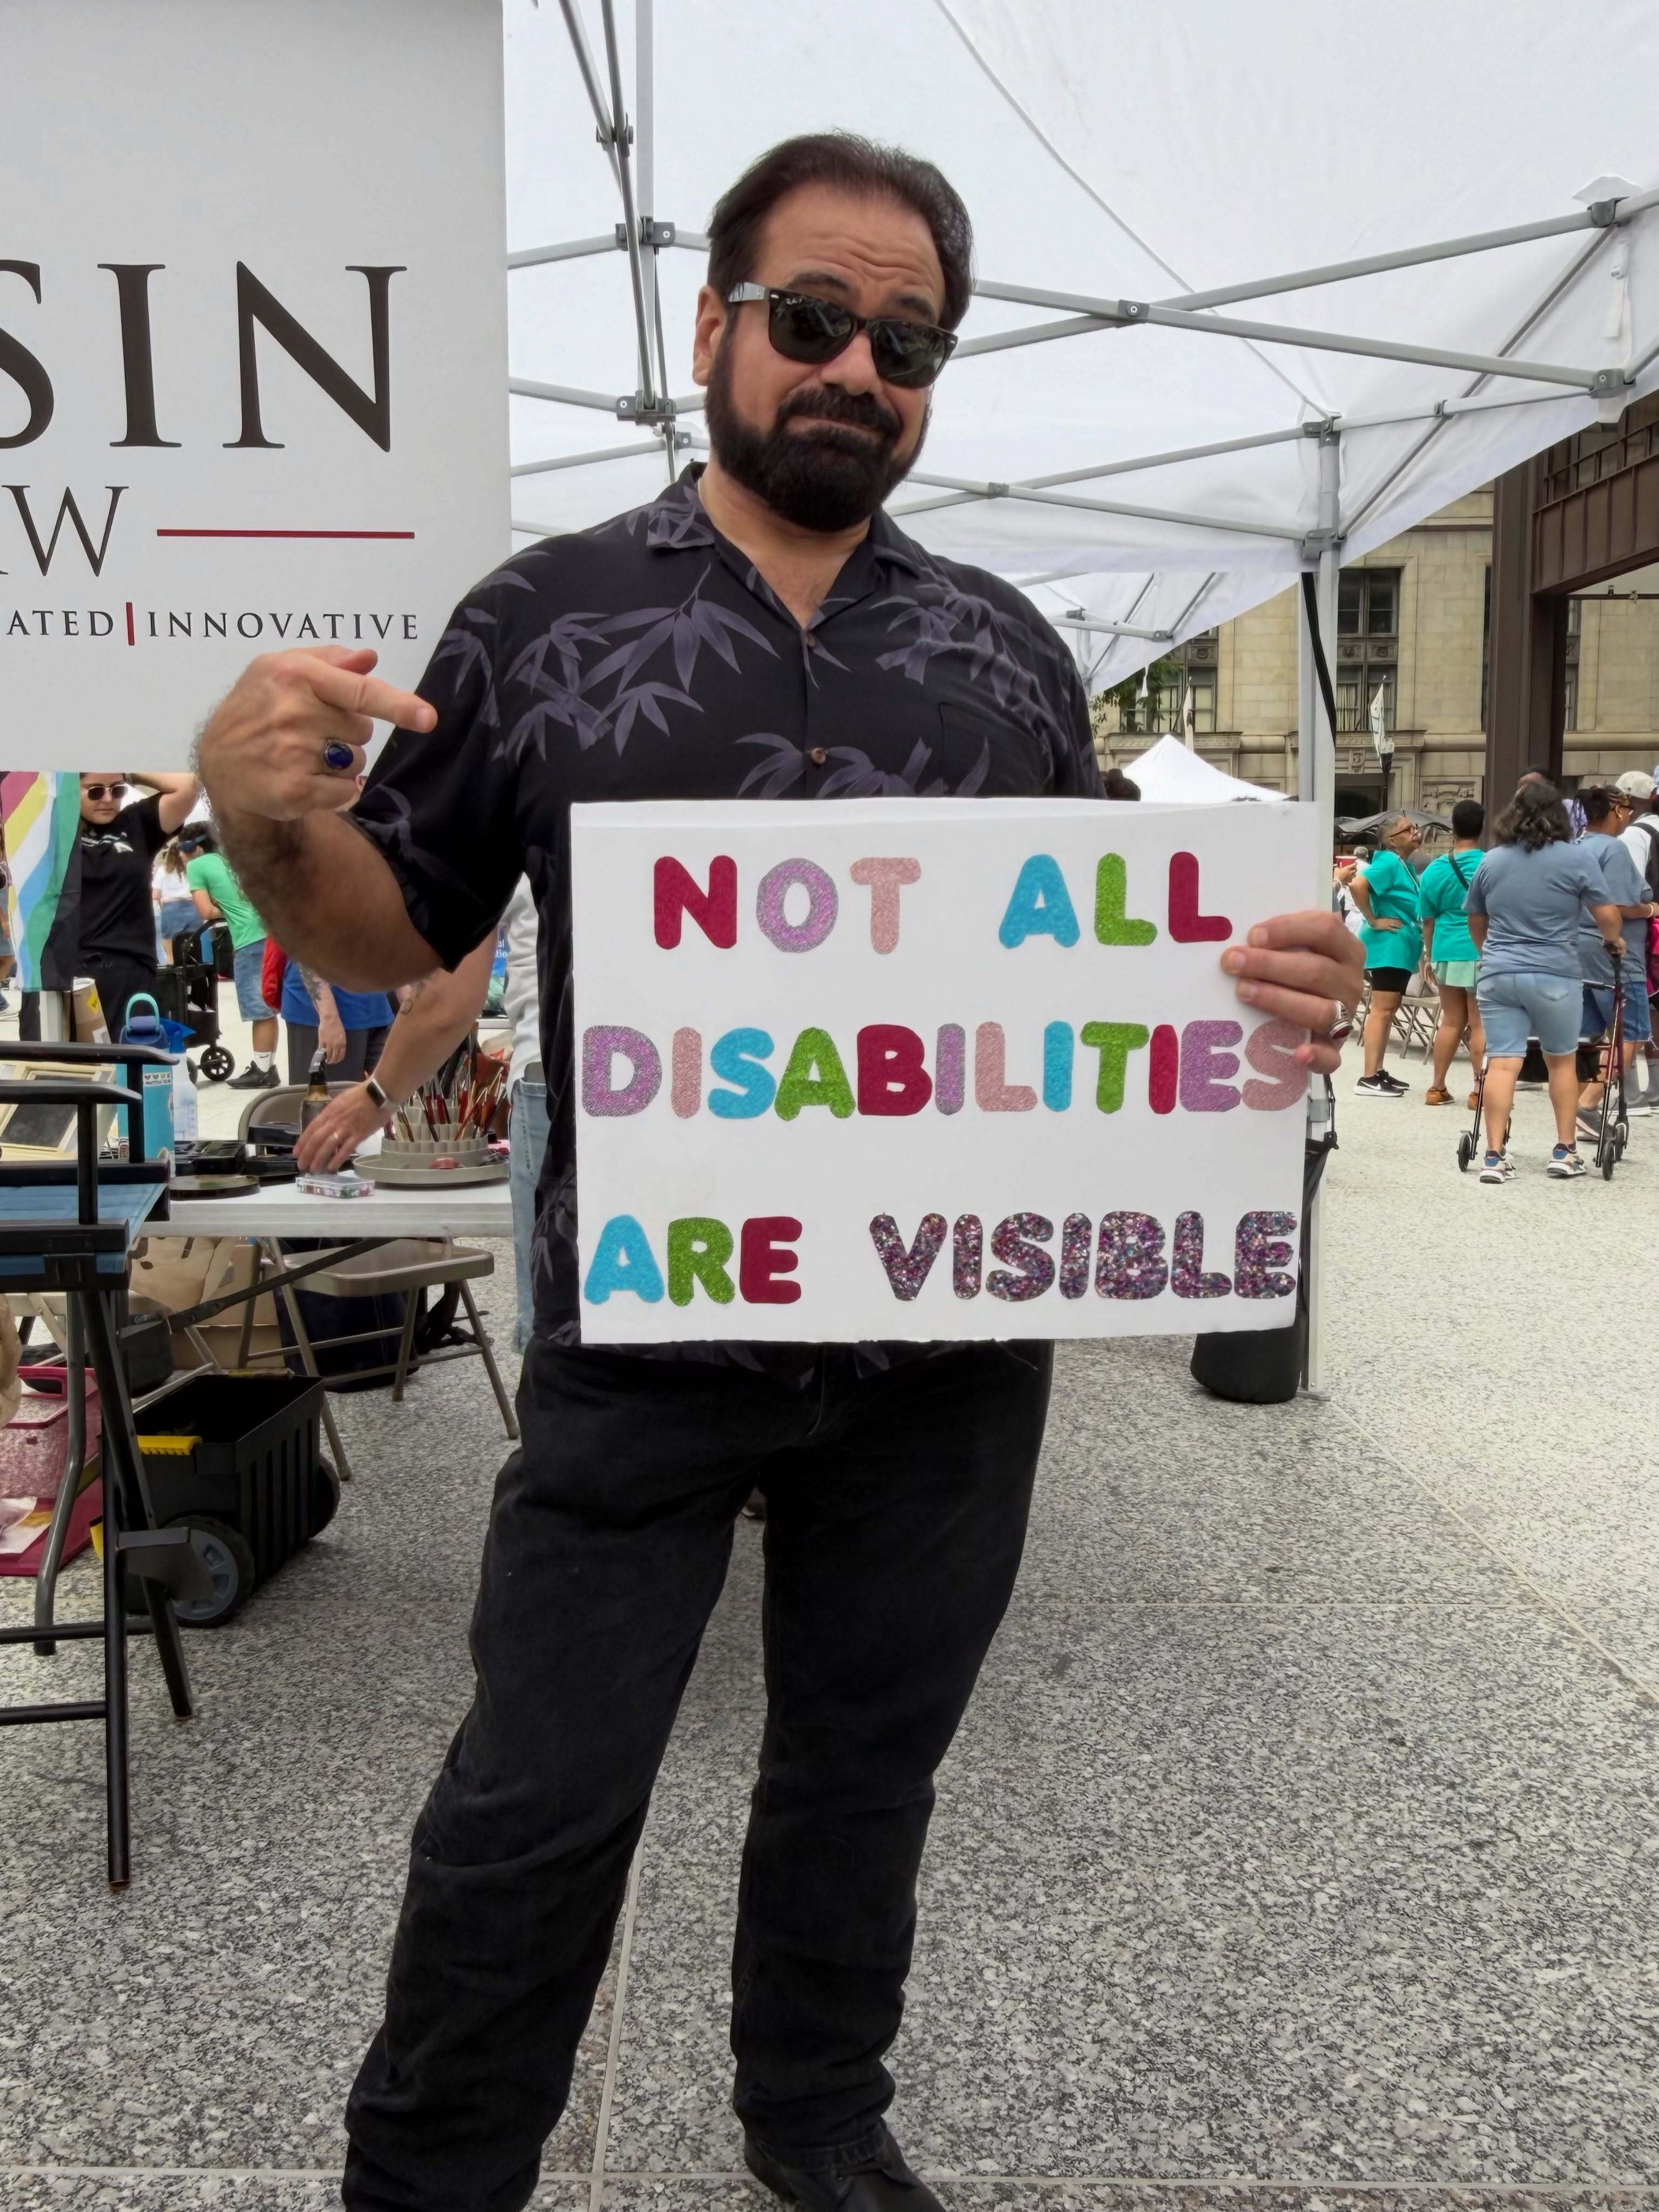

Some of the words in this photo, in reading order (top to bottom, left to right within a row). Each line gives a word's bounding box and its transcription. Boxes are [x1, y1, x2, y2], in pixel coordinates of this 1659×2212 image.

[0, 485, 129, 577] W
[149, 611, 417, 639] INNOVATIVE
[654, 855, 921, 954] NOT
[999, 851, 1233, 949] ALL
[582, 1020, 1309, 1121] DISABILITIES
[584, 1214, 802, 1307] ARE
[869, 1211, 1296, 1301] VISIBLE
